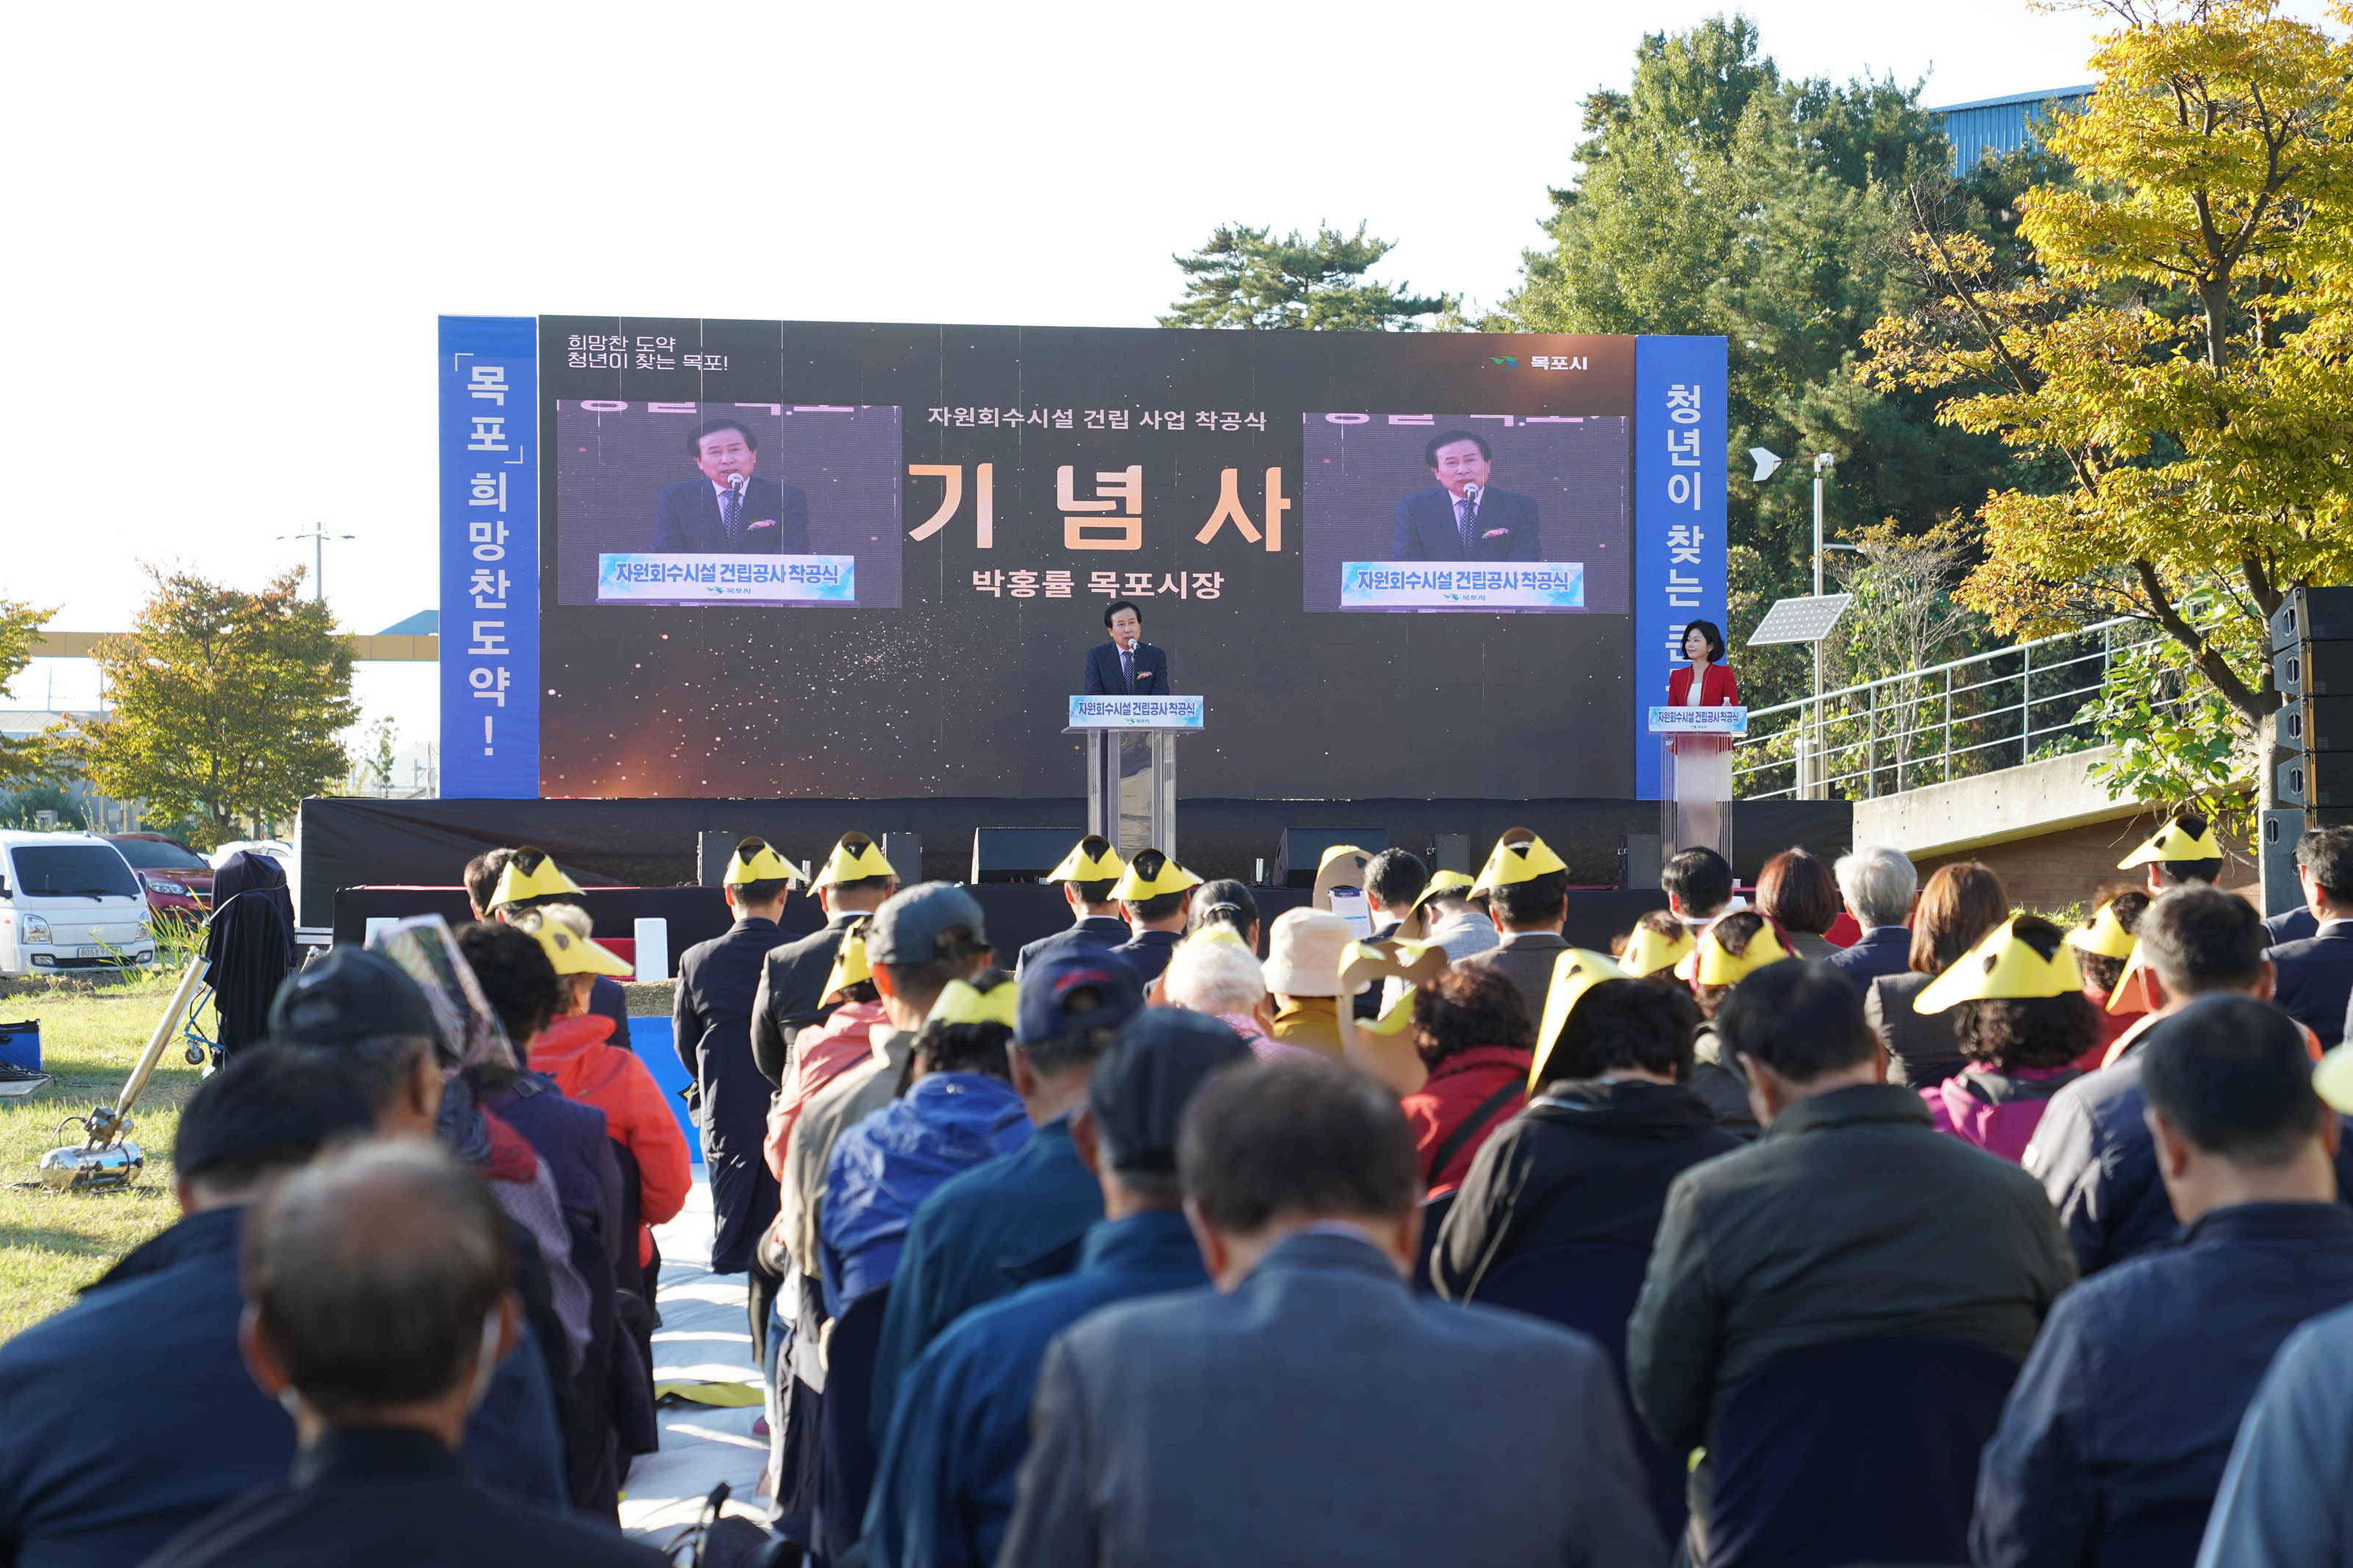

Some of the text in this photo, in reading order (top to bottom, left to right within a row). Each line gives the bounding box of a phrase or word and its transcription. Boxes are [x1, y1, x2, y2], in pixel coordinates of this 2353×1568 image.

[567, 334, 676, 353] 희망찬 도약
[567, 352, 728, 370] 청년이 찾는 목포!
[1530, 356, 1588, 370] 목포시
[927, 407, 1267, 432] 자원회수시설 건립 사업 착공식
[1665, 384, 1702, 511] 청년이
[615, 562, 838, 584] 자원회수시설 건립공사 착공식
[1665, 525, 1704, 606] 찾는
[971, 569, 1225, 600] 박홍률 목포시장
[1358, 570, 1568, 591] 자원회수시설 건립공사 착공식
[1078, 701, 1195, 716] 자원회수시설 건립공사 착공식
[1658, 711, 1739, 723] 자원회수시설 건립공사 착공식
